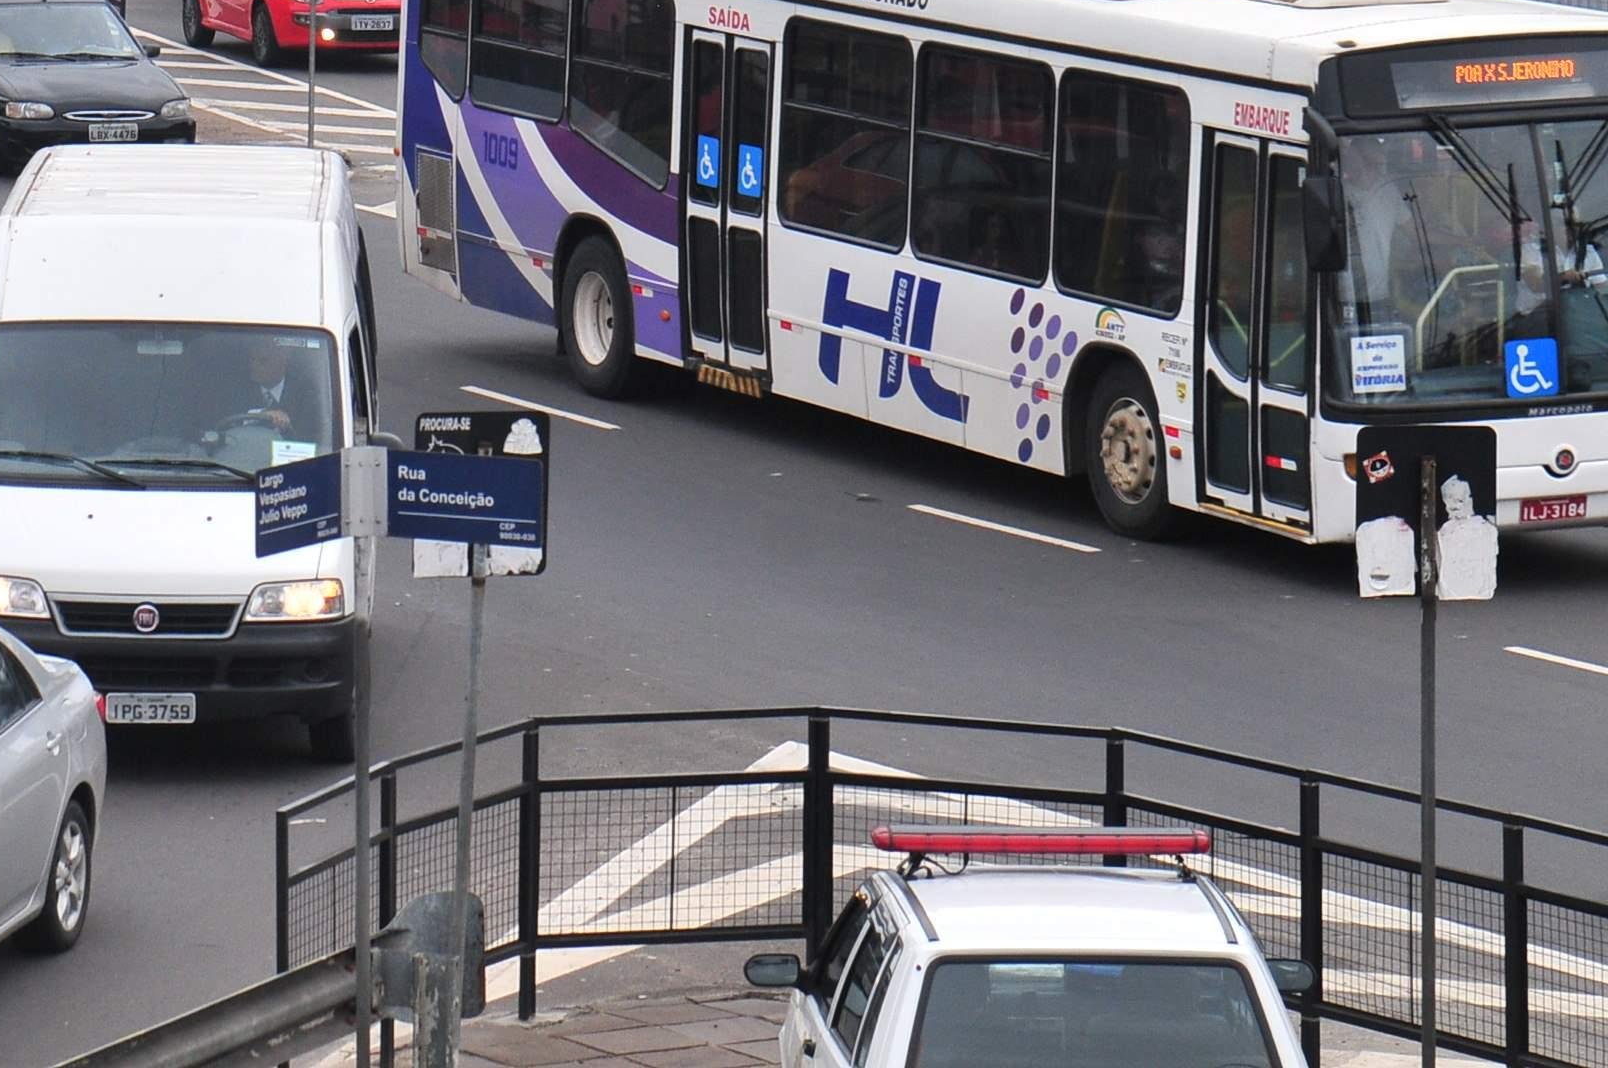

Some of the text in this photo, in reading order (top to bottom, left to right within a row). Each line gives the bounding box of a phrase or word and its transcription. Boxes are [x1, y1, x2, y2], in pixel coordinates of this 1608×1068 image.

[708, 5, 751, 32] SAÍDA
[1455, 64, 1483, 84] POA
[1484, 63, 1497, 82] X
[1234, 102, 1290, 135] EMBARQUE
[483, 130, 519, 171] 1009
[1528, 404, 1594, 416] Marcopolo
[419, 417, 472, 432] PROCURA-SE
[259, 472, 284, 490] Largo
[398, 465, 426, 481] Rua
[259, 485, 308, 507] Vespasiano
[397, 487, 495, 509] da Conceição
[282, 503, 308, 520] Veppo
[499, 522, 516, 531] CEP
